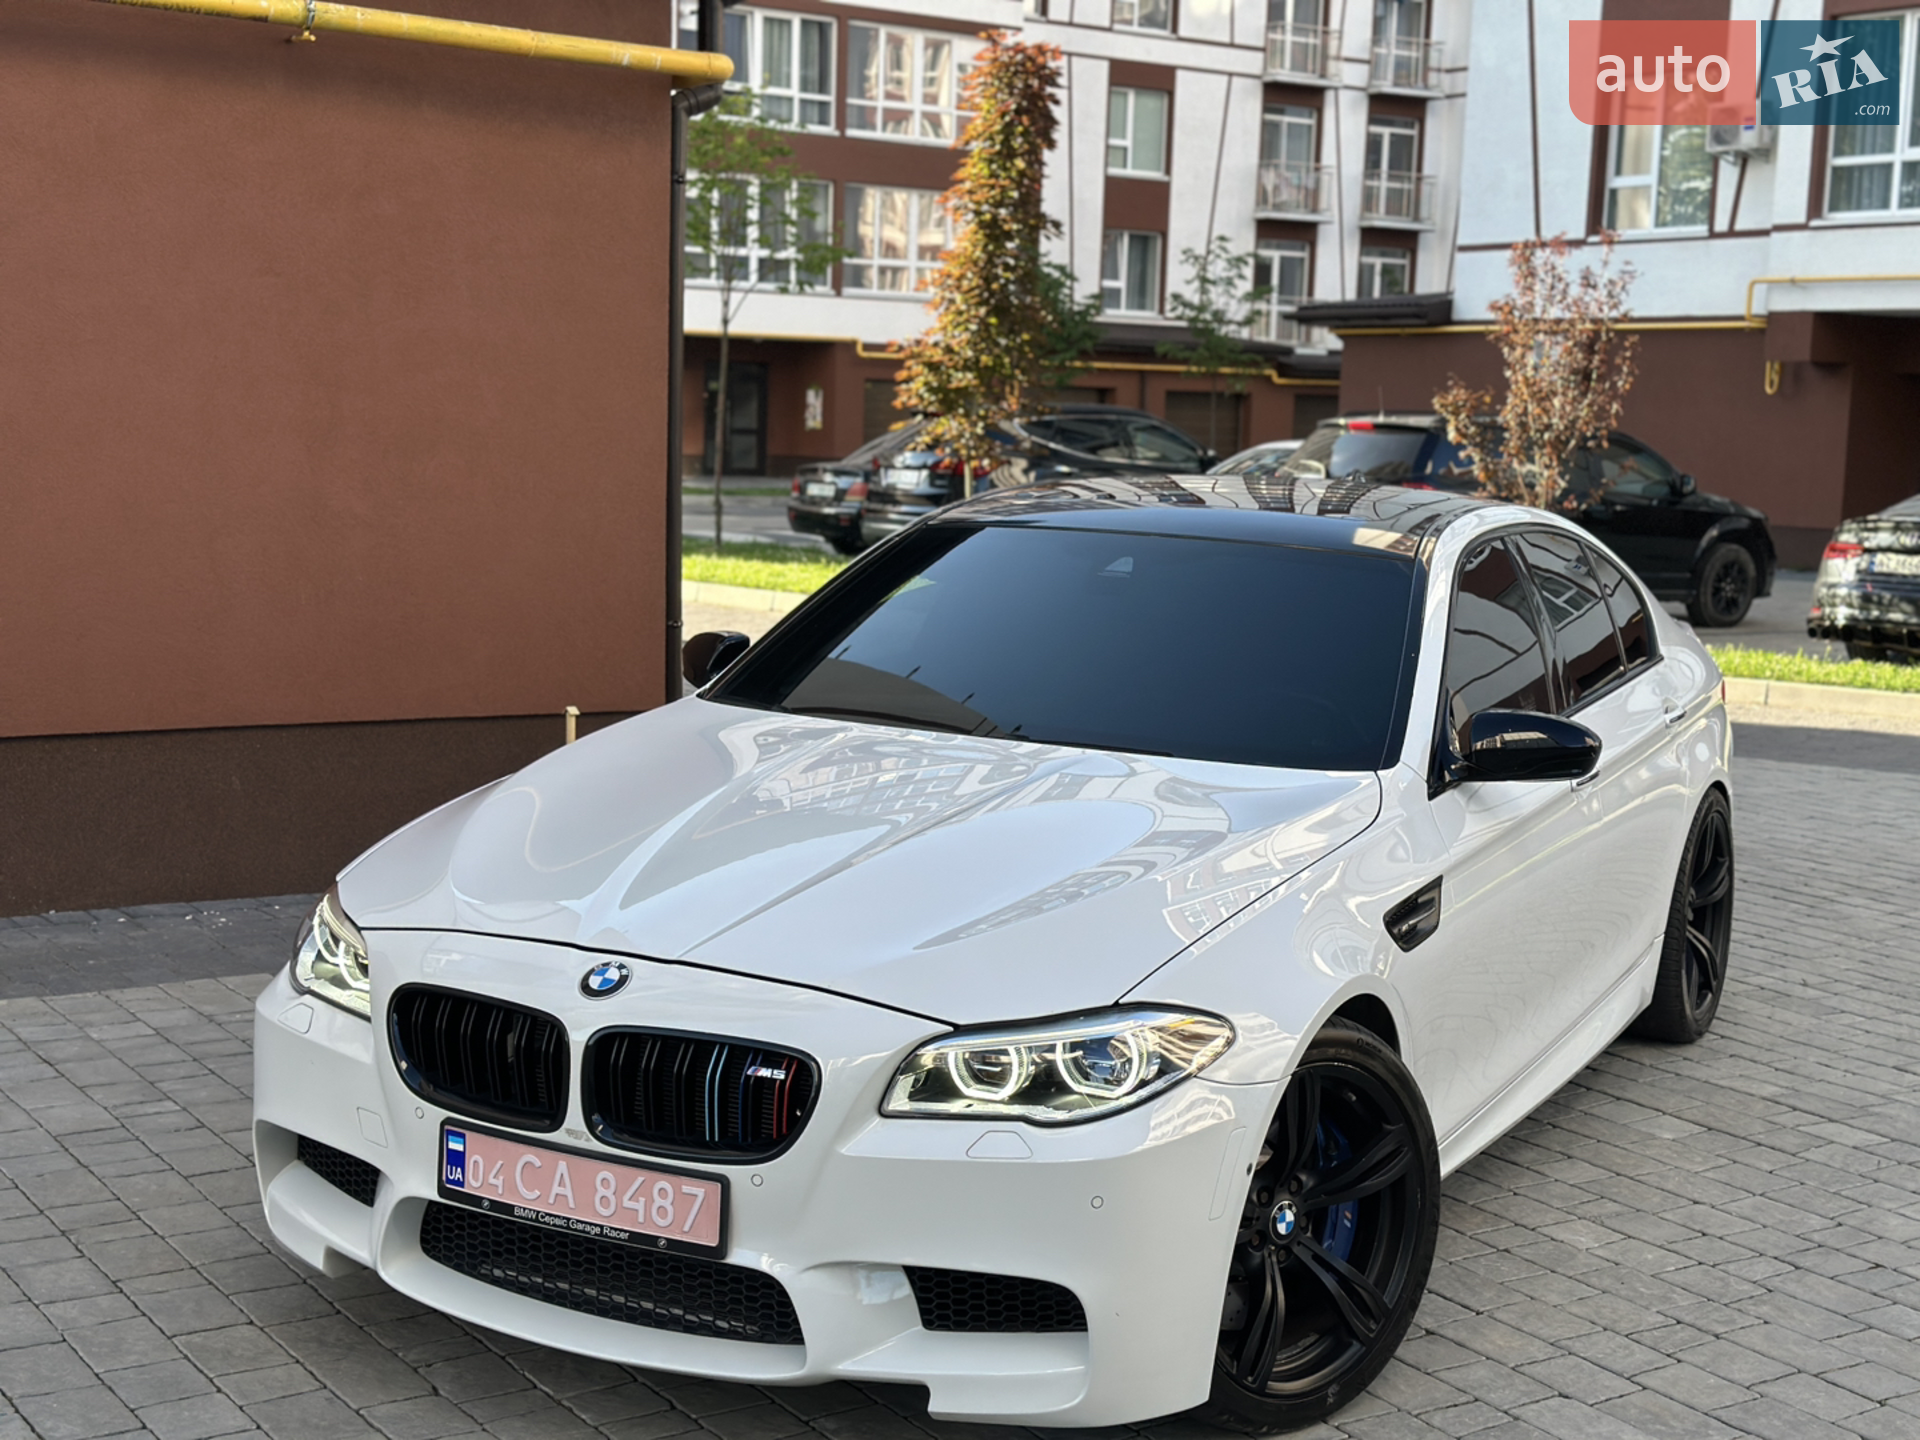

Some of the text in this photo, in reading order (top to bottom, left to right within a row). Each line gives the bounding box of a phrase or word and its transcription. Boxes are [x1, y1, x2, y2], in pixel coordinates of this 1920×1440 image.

[756, 1067, 786, 1080] M5
[447, 1165, 463, 1182] UA
[468, 1154, 706, 1233] 04 CA 8487
[514, 1206, 537, 1220] BMW
[569, 1219, 601, 1236] Garage
[603, 1226, 630, 1240] Racer
